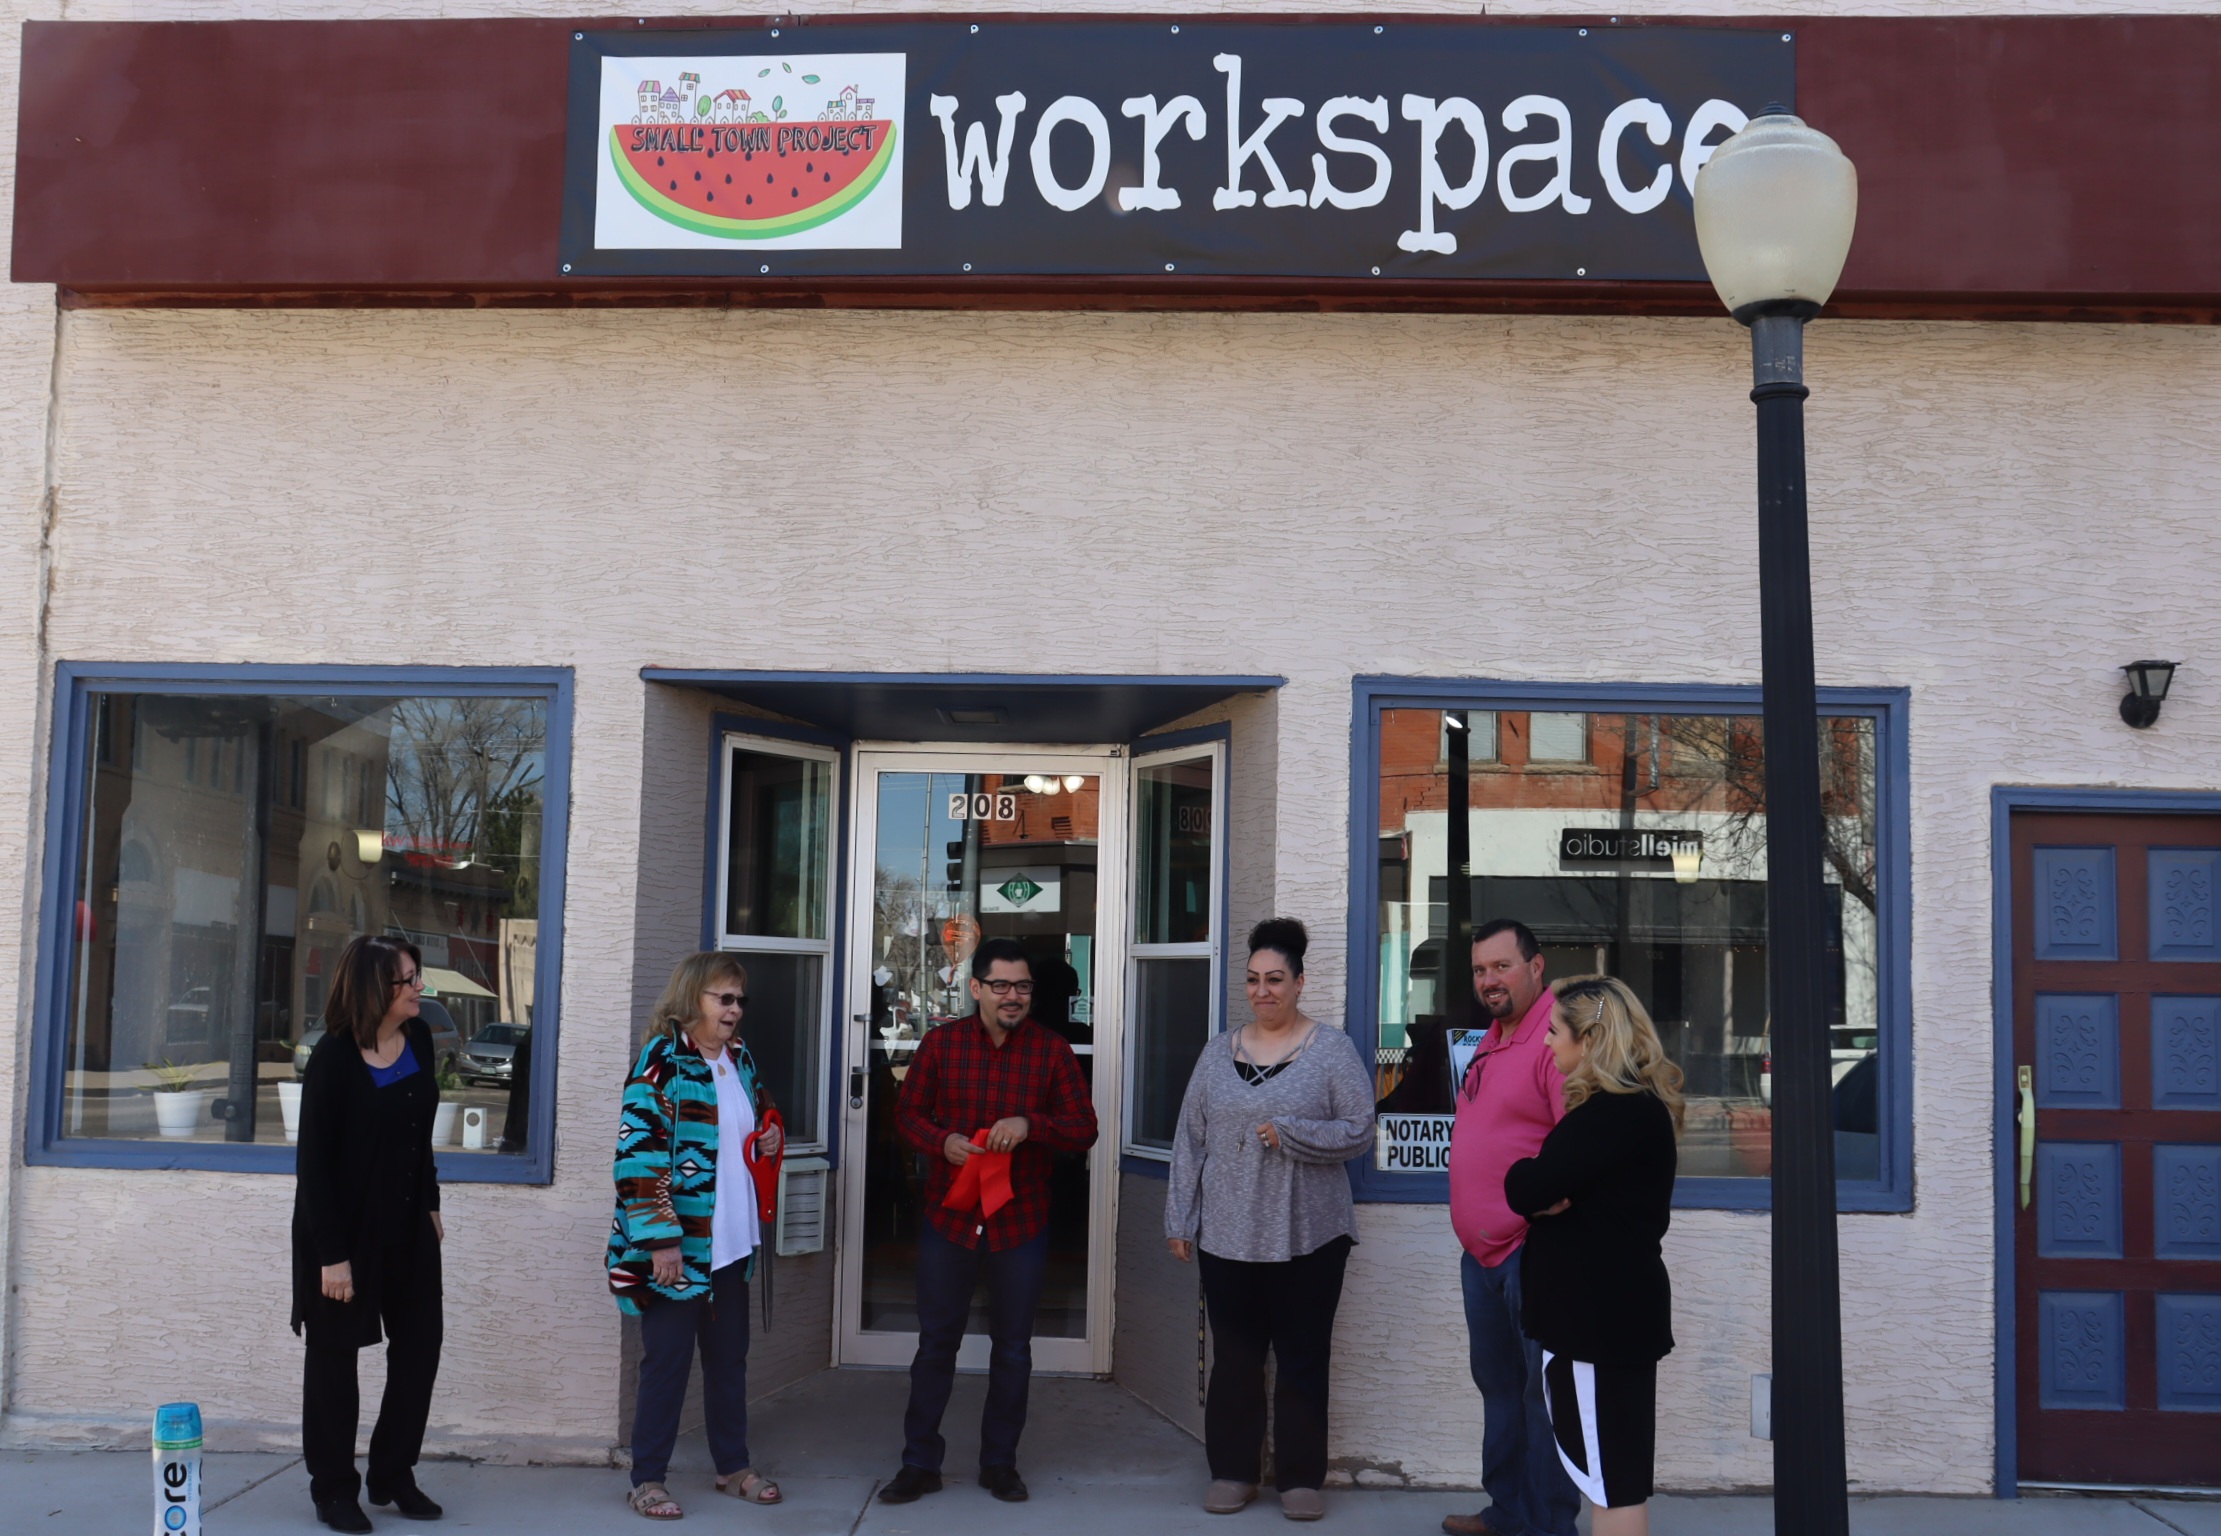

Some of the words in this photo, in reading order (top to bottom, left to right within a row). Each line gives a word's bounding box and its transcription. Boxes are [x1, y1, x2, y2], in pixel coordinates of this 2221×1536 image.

[631, 127, 704, 152] SMALL
[712, 126, 773, 152] TOWN
[778, 125, 879, 152] PROJECT
[952, 795, 1013, 819] 208
[1386, 1119, 1456, 1142] NOTARY
[1388, 1145, 1451, 1168] PUBLIC
